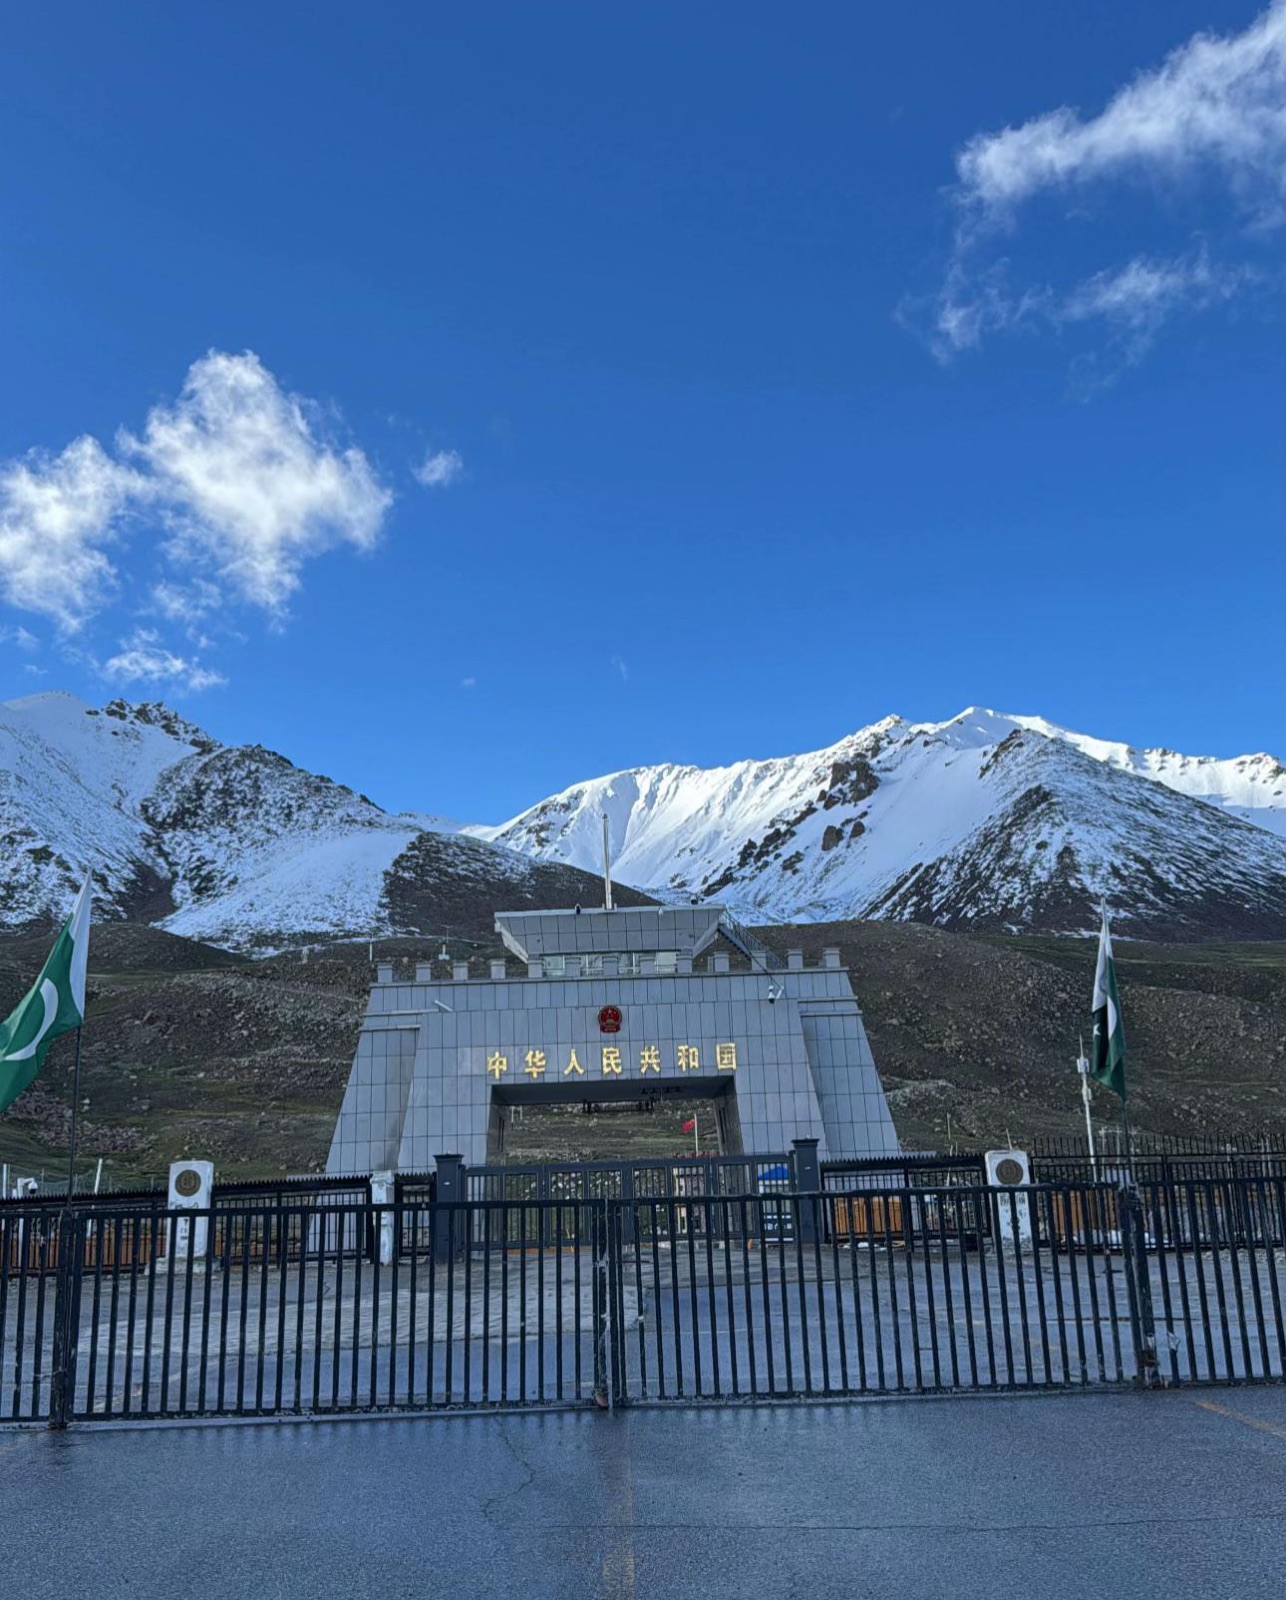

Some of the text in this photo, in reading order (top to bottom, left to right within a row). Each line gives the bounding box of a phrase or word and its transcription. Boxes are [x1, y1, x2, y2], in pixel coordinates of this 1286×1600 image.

[487, 1043, 737, 1079] 中华人民共和国
